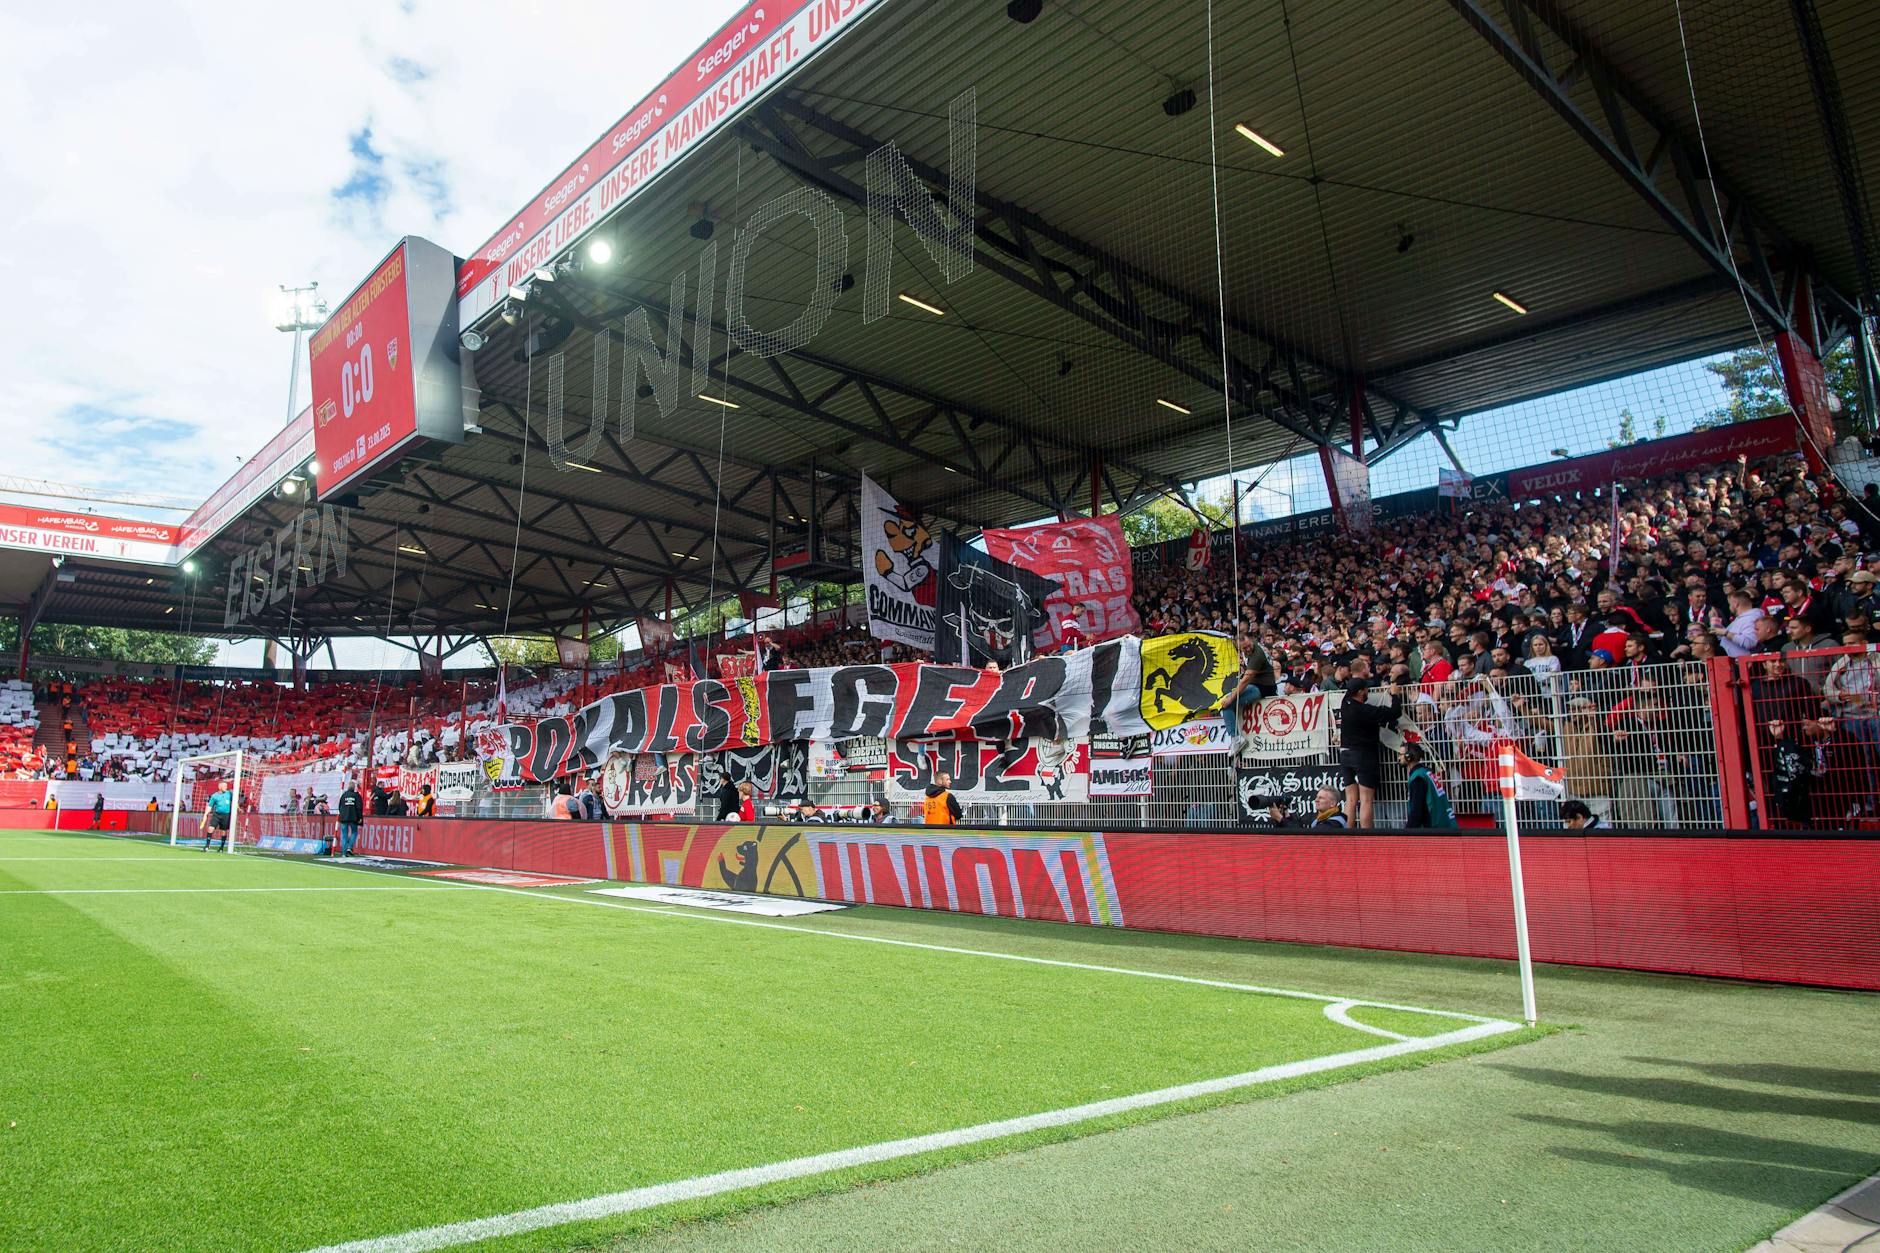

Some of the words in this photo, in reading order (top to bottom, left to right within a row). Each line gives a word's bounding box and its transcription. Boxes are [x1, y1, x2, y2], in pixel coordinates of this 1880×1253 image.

[697, 25, 748, 82] Seeger
[612, 108, 654, 155] Seeger
[508, 230, 551, 287] UNSERE
[555, 197, 594, 248] LIEBE.
[600, 139, 659, 210] UNSERE
[664, 26, 799, 160] MANNSCHAFT.
[543, 175, 578, 216] Seeger
[486, 231, 515, 266] Seeger
[547, 86, 976, 472] UNION
[342, 343, 374, 418] 0:0
[1521, 469, 1580, 492] VELUX
[43, 533, 99, 553] VEREIN.
[225, 504, 348, 629] EISERN
[1251, 735, 1313, 756] Stuttgart
